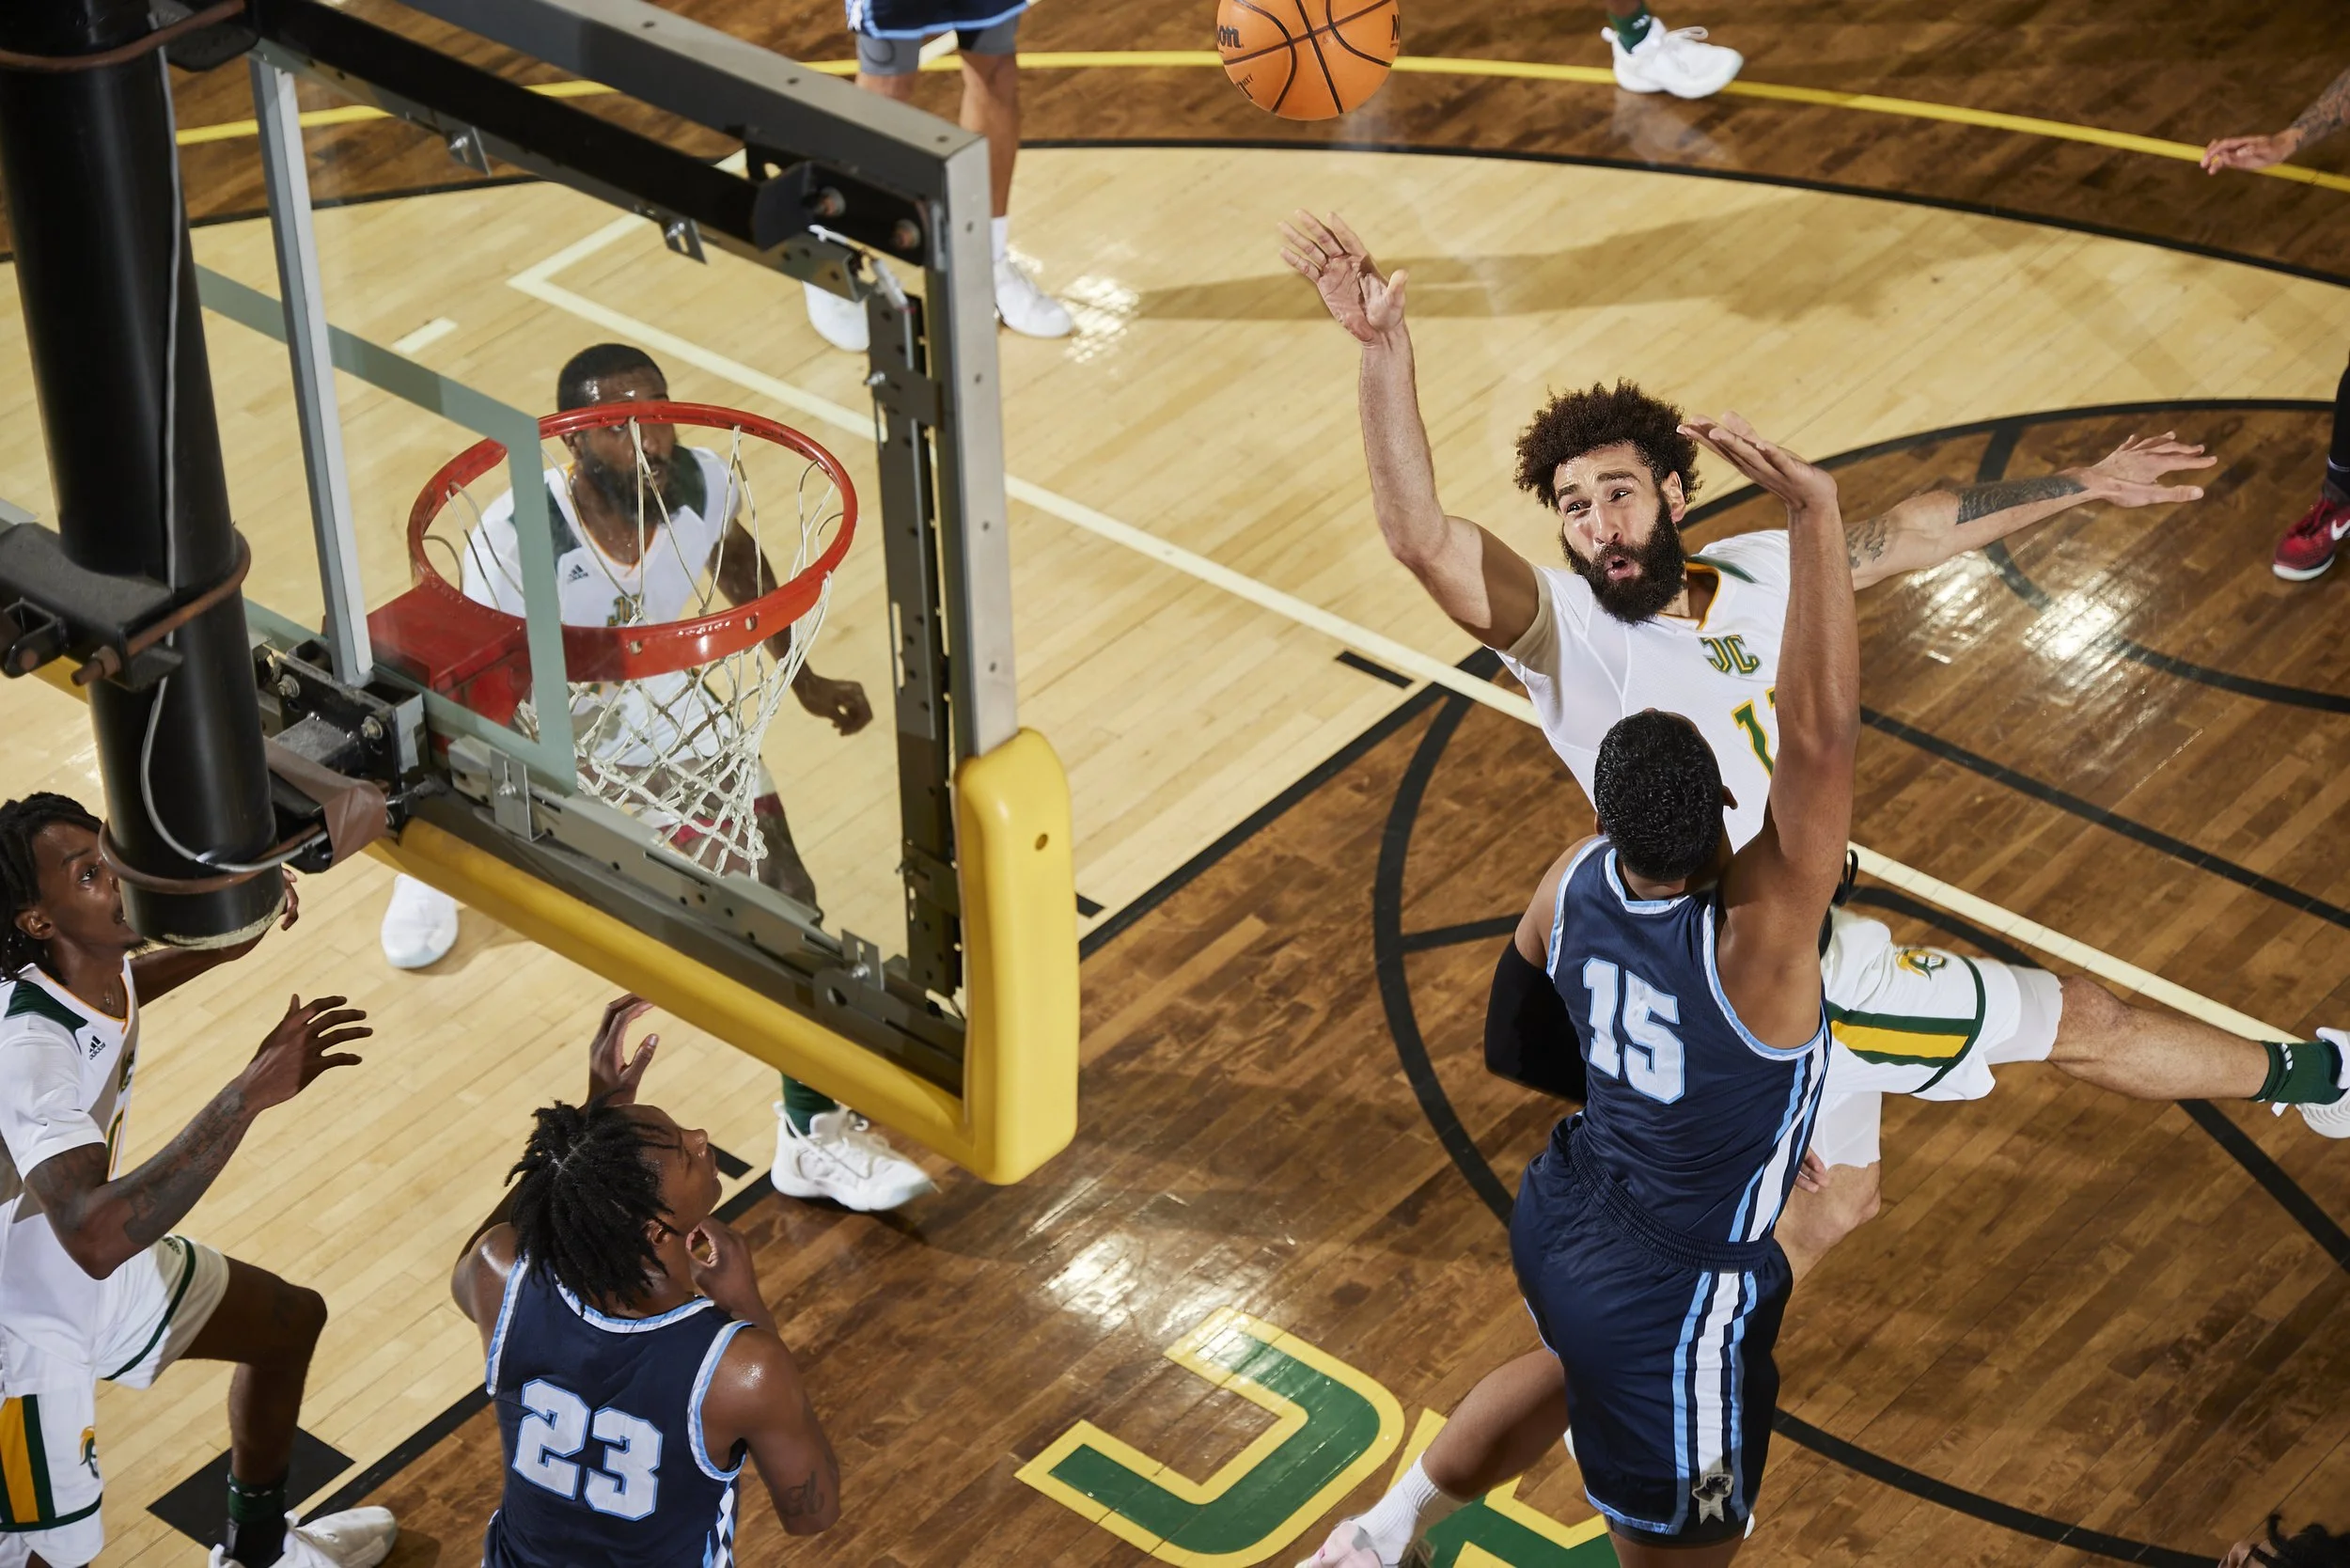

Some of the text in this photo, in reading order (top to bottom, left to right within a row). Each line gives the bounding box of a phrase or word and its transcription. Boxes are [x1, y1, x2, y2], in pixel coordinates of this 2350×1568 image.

[1698, 634, 1763, 677] JC
[1731, 685, 1776, 780] 1
[89, 1042, 106, 1060] adidas
[1583, 957, 1685, 1105] 15
[511, 1378, 664, 1522] 23
